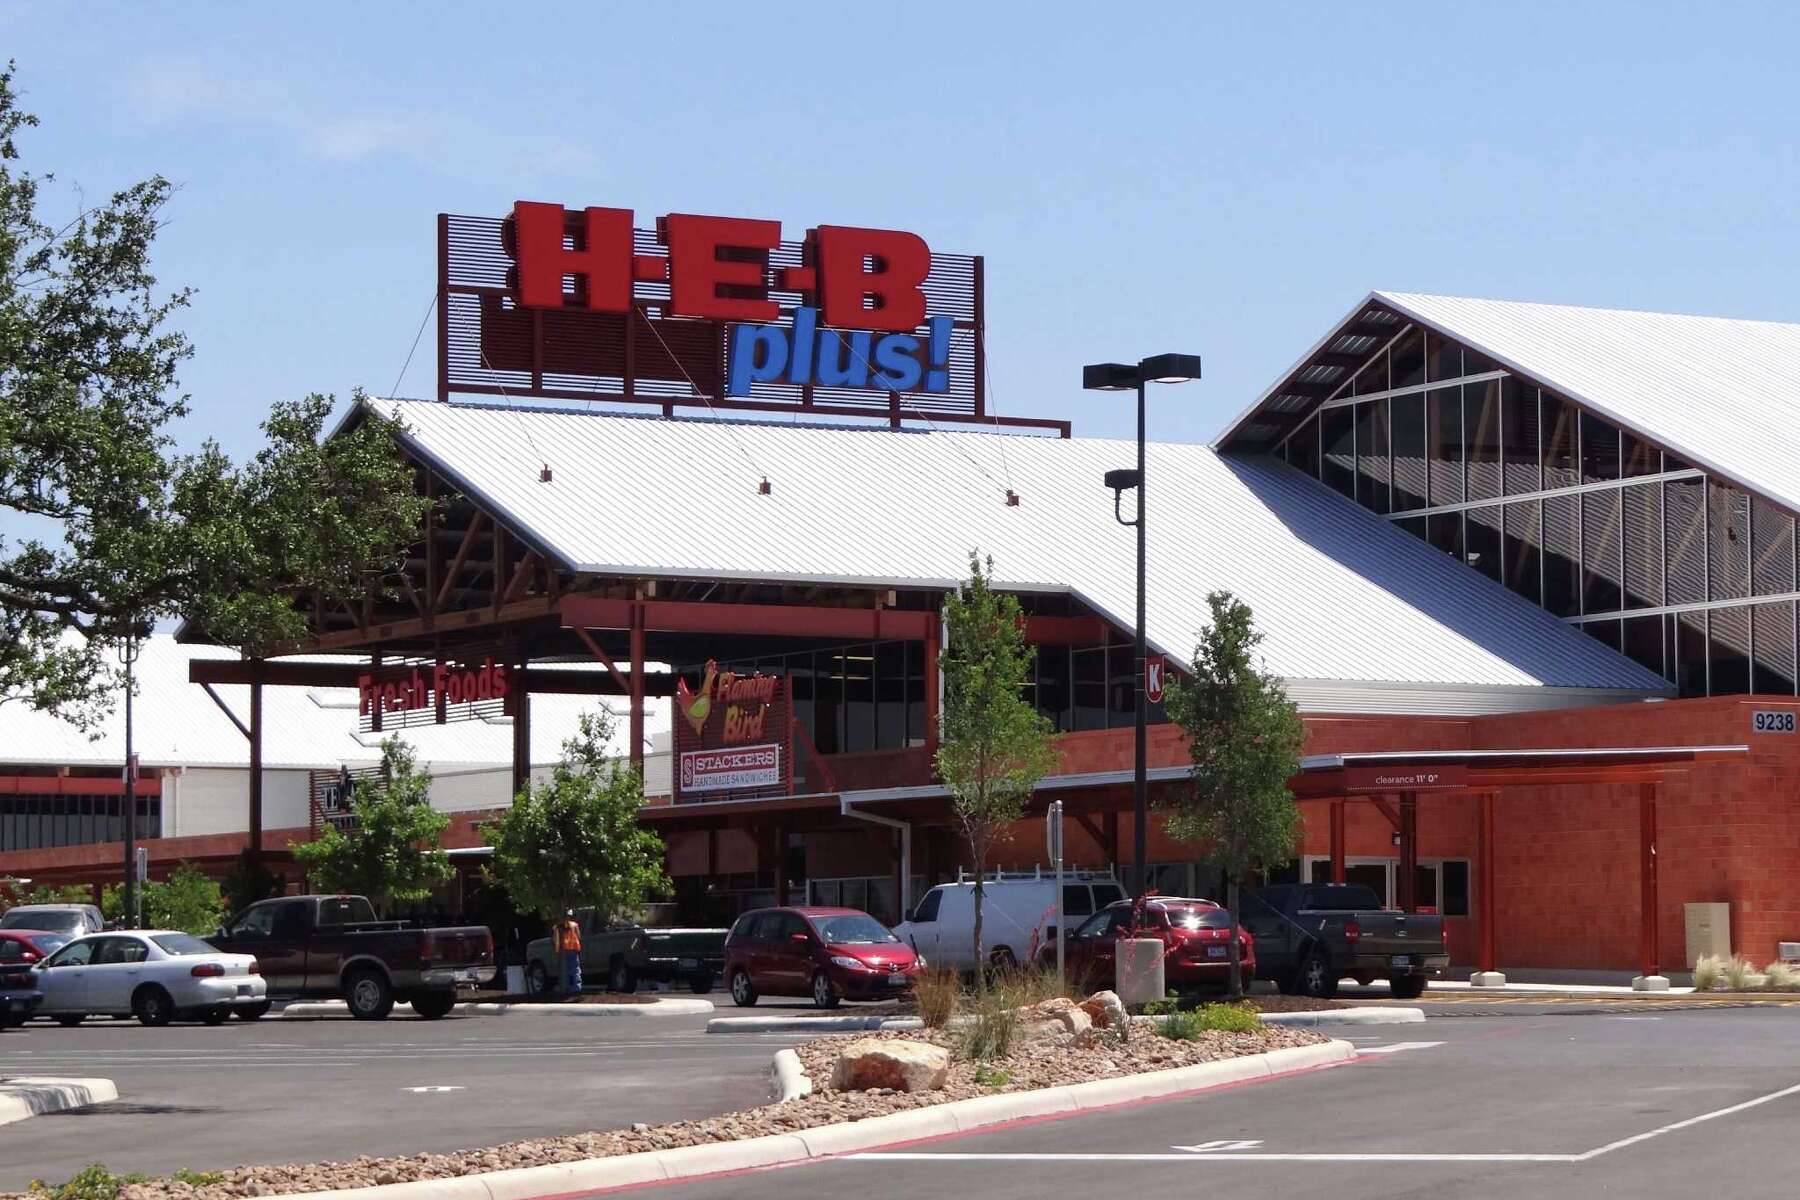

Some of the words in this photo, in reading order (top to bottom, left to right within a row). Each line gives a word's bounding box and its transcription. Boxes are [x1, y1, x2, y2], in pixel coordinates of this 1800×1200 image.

[514, 200, 932, 331] H-E-B
[726, 306, 955, 398] plus!
[359, 668, 425, 716] Fresh
[434, 657, 507, 705] Foods
[717, 671, 778, 702] Flaming
[1149, 663, 1161, 693] K
[723, 703, 768, 743] Bird
[1756, 713, 1794, 731] 9238
[695, 751, 775, 771] STACKERS
[694, 773, 731, 787] HANDMADE
[1375, 775, 1415, 785] clearance
